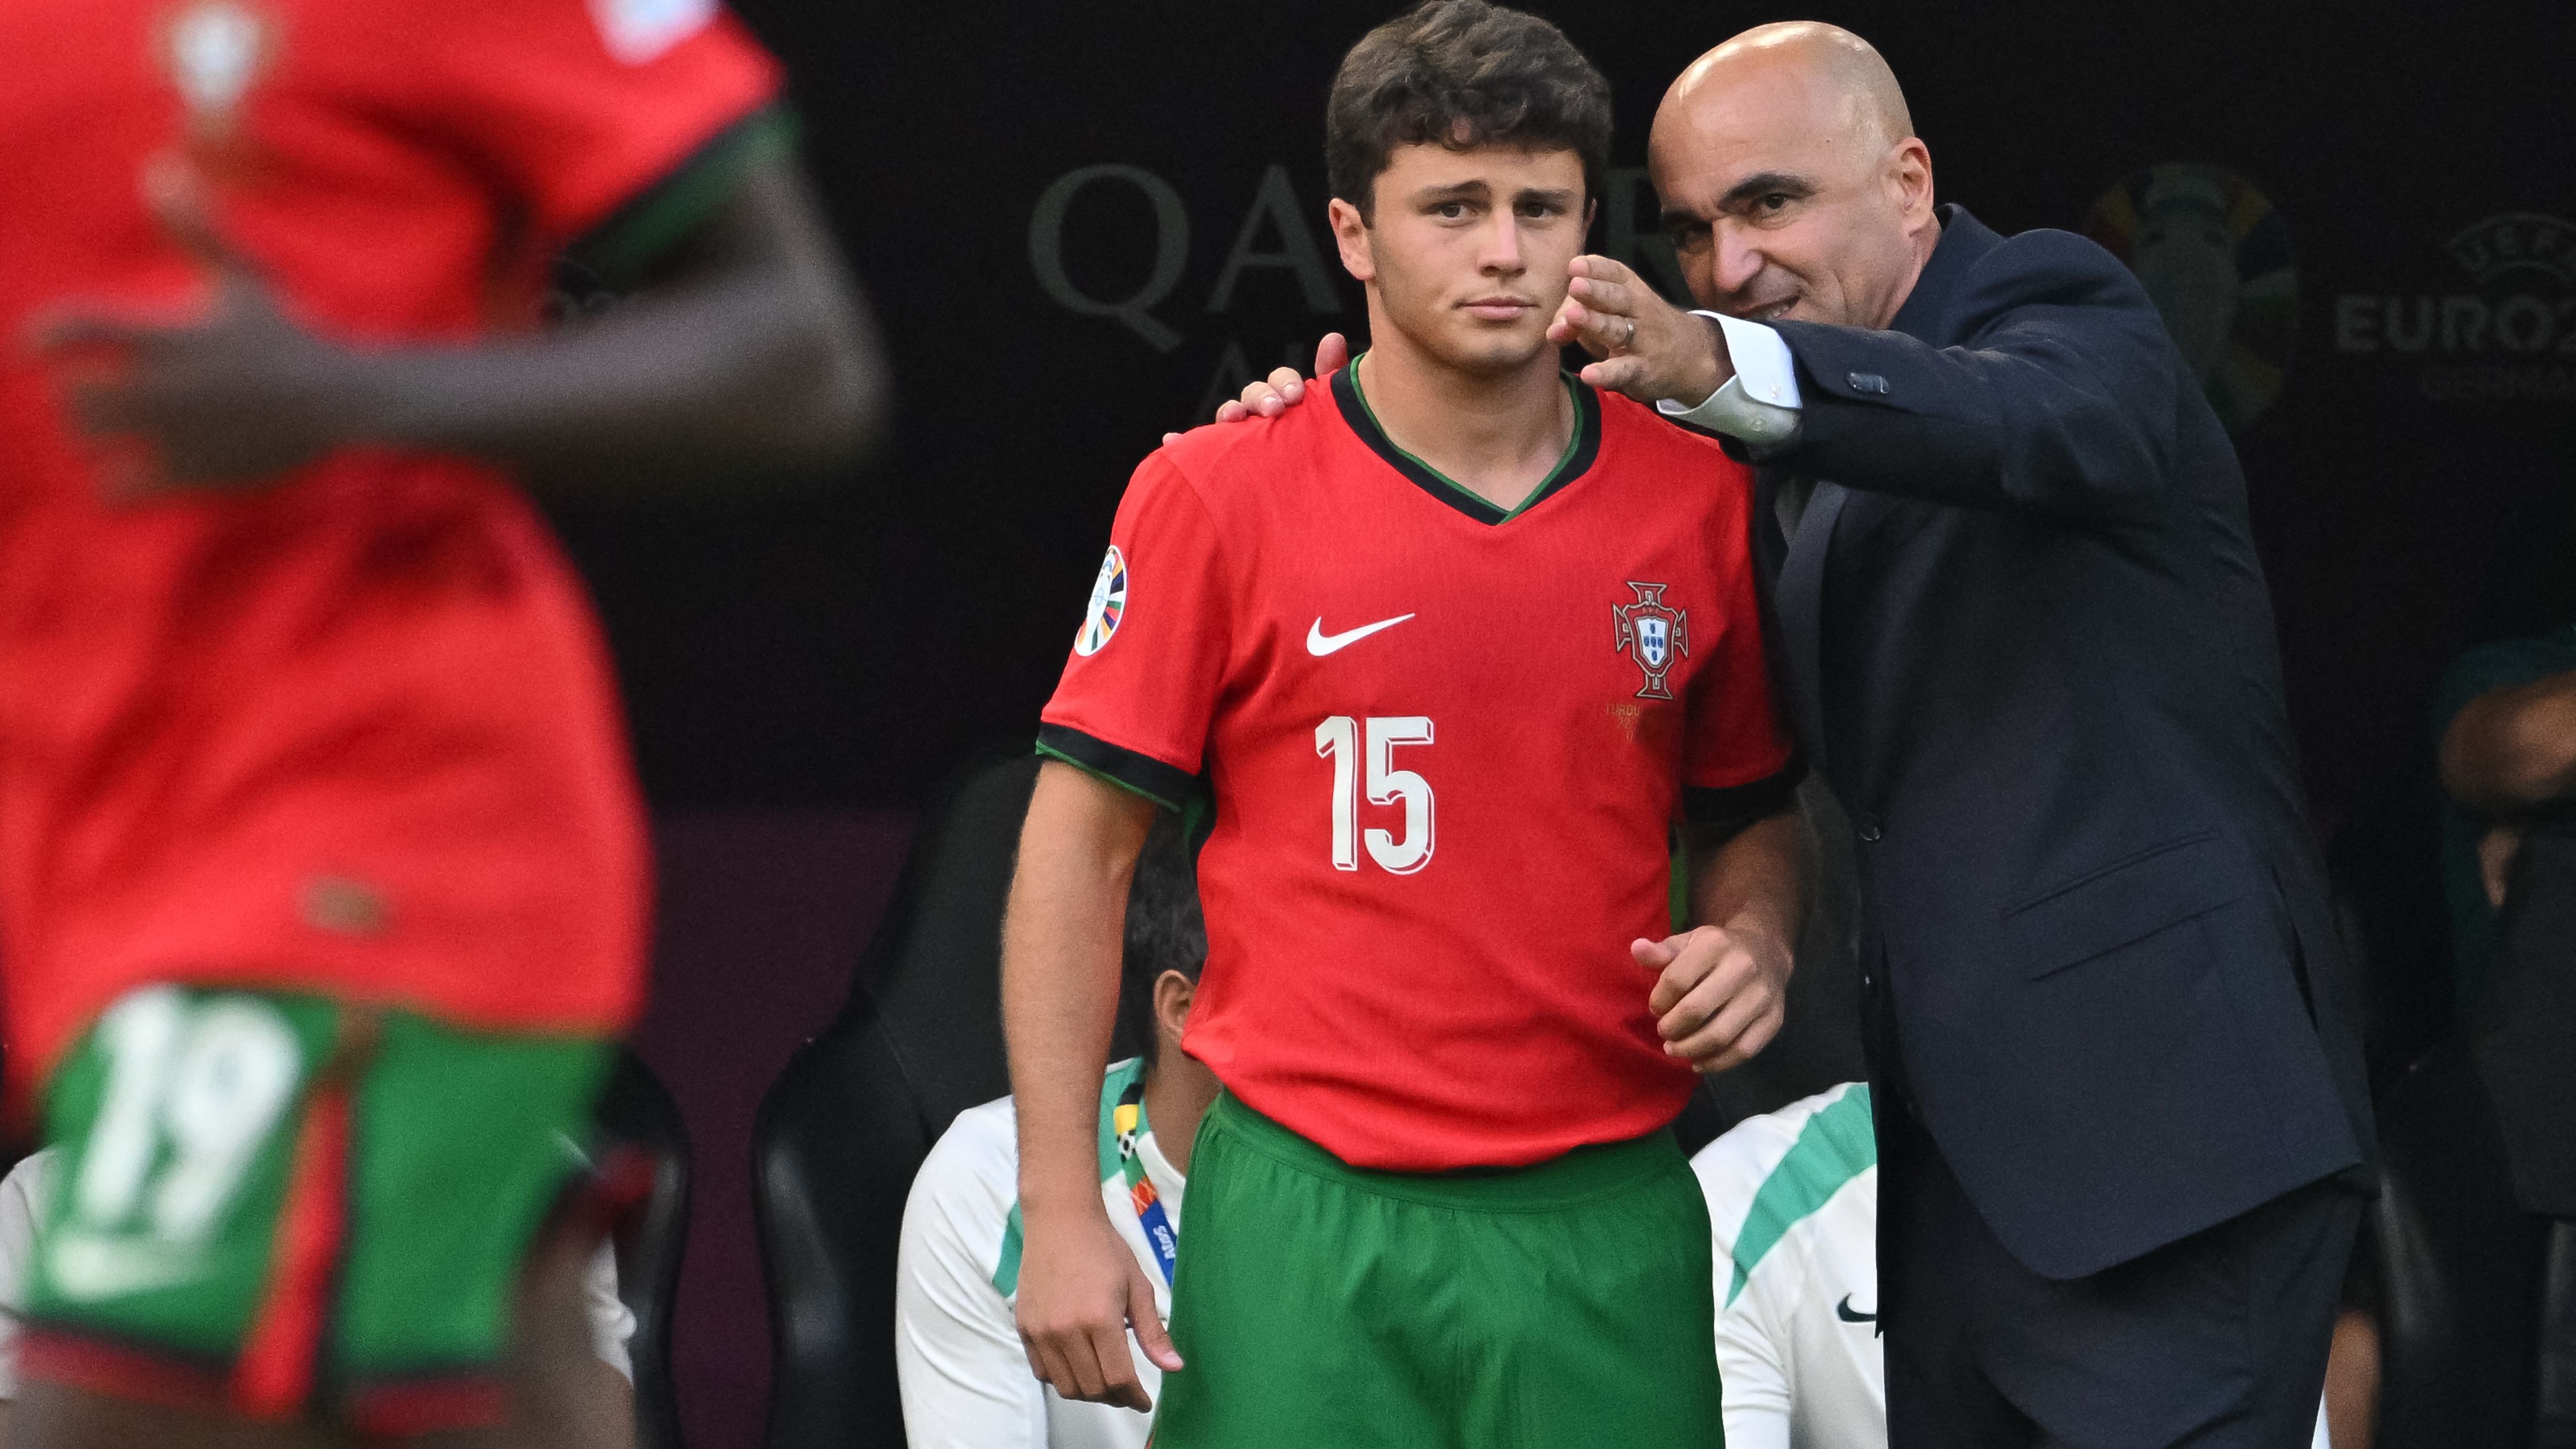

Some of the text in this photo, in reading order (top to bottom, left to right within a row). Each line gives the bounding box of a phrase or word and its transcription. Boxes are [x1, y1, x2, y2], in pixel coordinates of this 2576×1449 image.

[1027, 163, 1699, 352] QAR
[1315, 715, 1434, 875] 15
[76, 982, 309, 1242] 19
